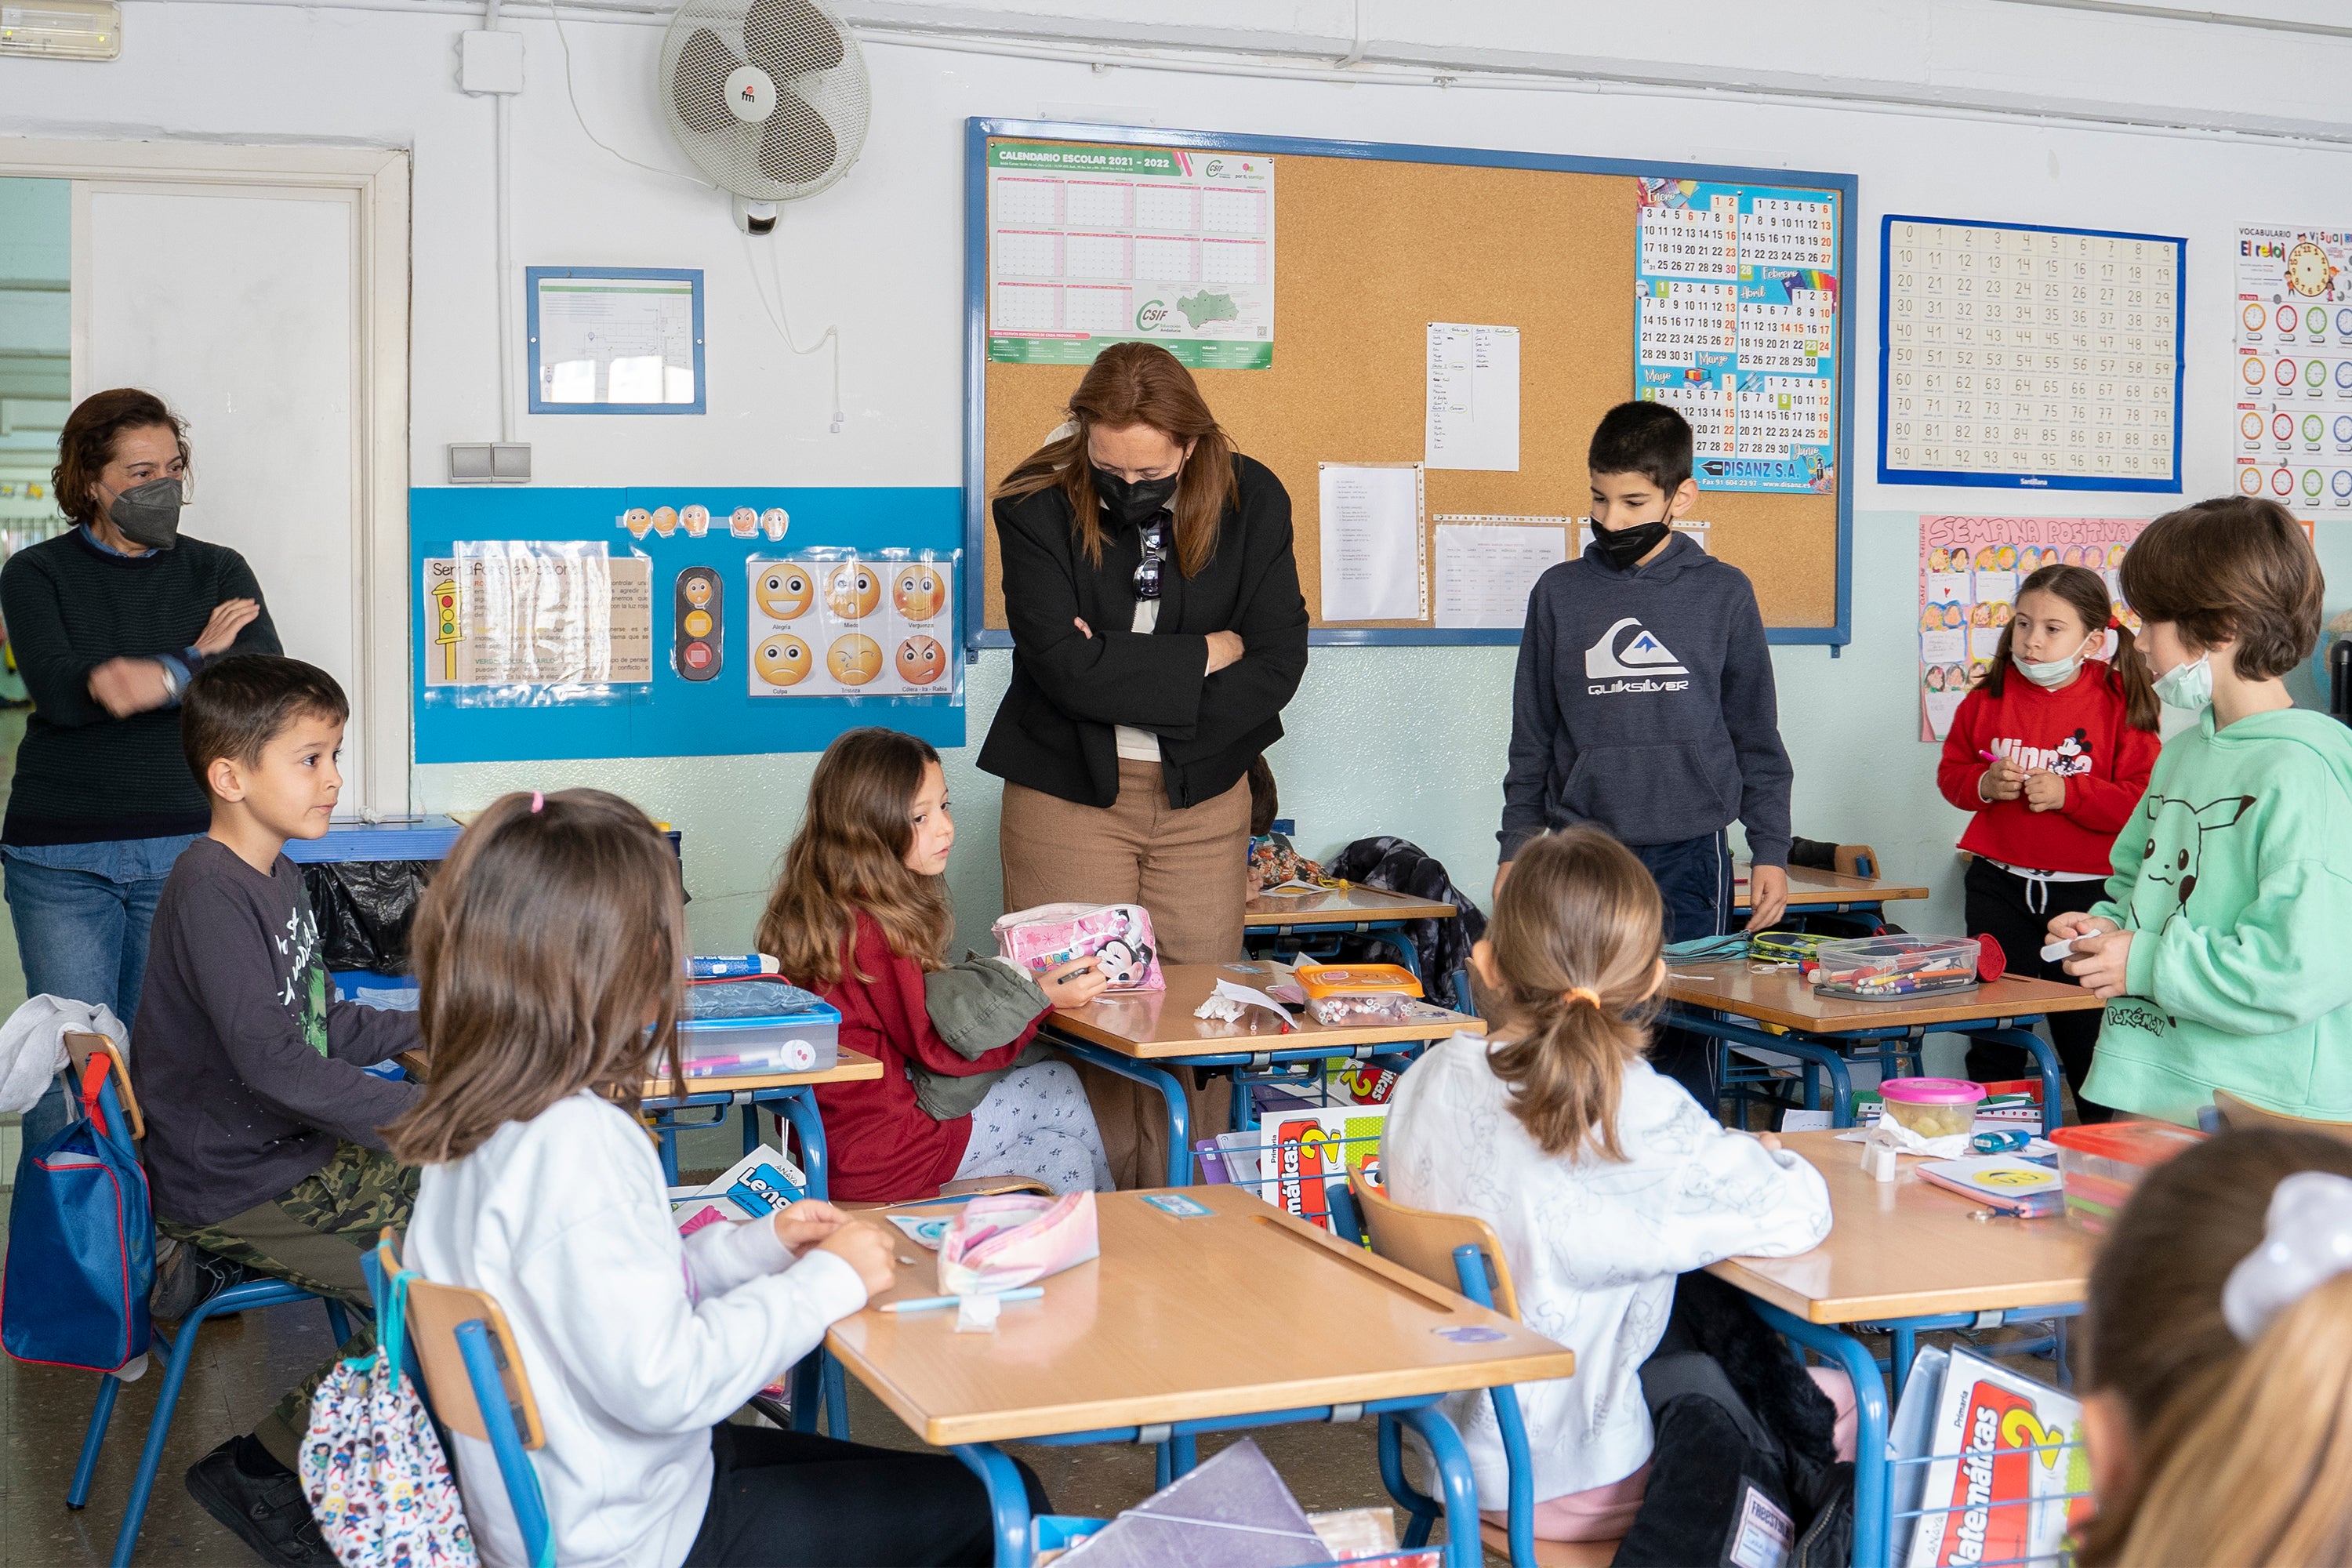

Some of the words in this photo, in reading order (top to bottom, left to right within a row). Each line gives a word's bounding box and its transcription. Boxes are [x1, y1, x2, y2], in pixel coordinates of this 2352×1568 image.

[742, 90, 755, 103] fm
[999, 151, 1059, 162] CALENDARIO
[1062, 154, 1105, 164] ESCOLAR
[1109, 156, 1133, 165] 2021
[1144, 158, 1170, 168] 2022
[1647, 189, 1676, 203] Enero
[1646, 209, 1653, 218] 3
[1661, 209, 1667, 219] 4
[1675, 210, 1680, 220] 5
[1688, 211, 1693, 221] 6
[1701, 212, 1707, 221] 7
[1715, 212, 1720, 223] 8
[1728, 214, 1734, 224] 9
[1744, 215, 1749, 224] 7
[1757, 216, 1763, 226] 8
[1770, 216, 1777, 227] 9
[1781, 218, 1791, 228] 10
[1795, 219, 1804, 228] 11
[1807, 220, 1818, 230] 12
[1820, 221, 1831, 230] 13
[1644, 225, 1655, 235] 10
[1658, 226, 1668, 236] 11
[1671, 227, 1682, 237] 12
[1685, 228, 1696, 238] 13
[1699, 229, 1709, 238] 14
[1712, 230, 1723, 240] 15
[1726, 230, 1737, 241] 16
[2239, 228, 2291, 238] VOCABULARIO
[2241, 240, 2252, 256] El
[2256, 241, 2286, 262] reloj
[1762, 266, 1799, 281] Febrero
[1739, 284, 1767, 301] Abril
[1897, 274, 1913, 287] 20
[1928, 276, 1942, 289] 21
[1957, 278, 1973, 292] 22
[1986, 280, 2001, 293] 23
[2016, 282, 2031, 295] 24
[2045, 284, 2059, 297] 25
[2072, 286, 2087, 299] 26
[2100, 288, 2114, 300] 27
[2128, 290, 2142, 303] 28
[2155, 292, 2170, 304] 29
[1142, 309, 1168, 321] CSIF
[1698, 351, 1730, 368] Marzo
[1645, 368, 1673, 385] Mayo
[1740, 409, 1750, 419] 13
[1753, 410, 1763, 419] 14
[1766, 410, 1777, 420] 15
[1779, 411, 1790, 421] 16
[1792, 412, 1802, 421] 17
[1806, 412, 1816, 422] 18
[1818, 412, 1828, 423] 19
[1792, 442, 1819, 461] Junio
[1724, 461, 1770, 478] DISANZ
[1776, 463, 1800, 480] S.A.
[2020, 477, 2049, 486] Santillana
[1929, 516, 2041, 547] SEMANA
[2046, 519, 2131, 544] POSITIVA
[1588, 679, 1690, 695] QUIKSILVER
[1991, 737, 2092, 776] Minne
[1032, 952, 1070, 967] MADE
[1341, 1063, 1372, 1096] 2
[1301, 1129, 1341, 1164] 2
[737, 1167, 795, 1210] Leng
[1954, 1390, 1969, 1428] Primaria
[2001, 1408, 2065, 1470] 2
[1927, 1515, 1946, 1556] ANAYA
